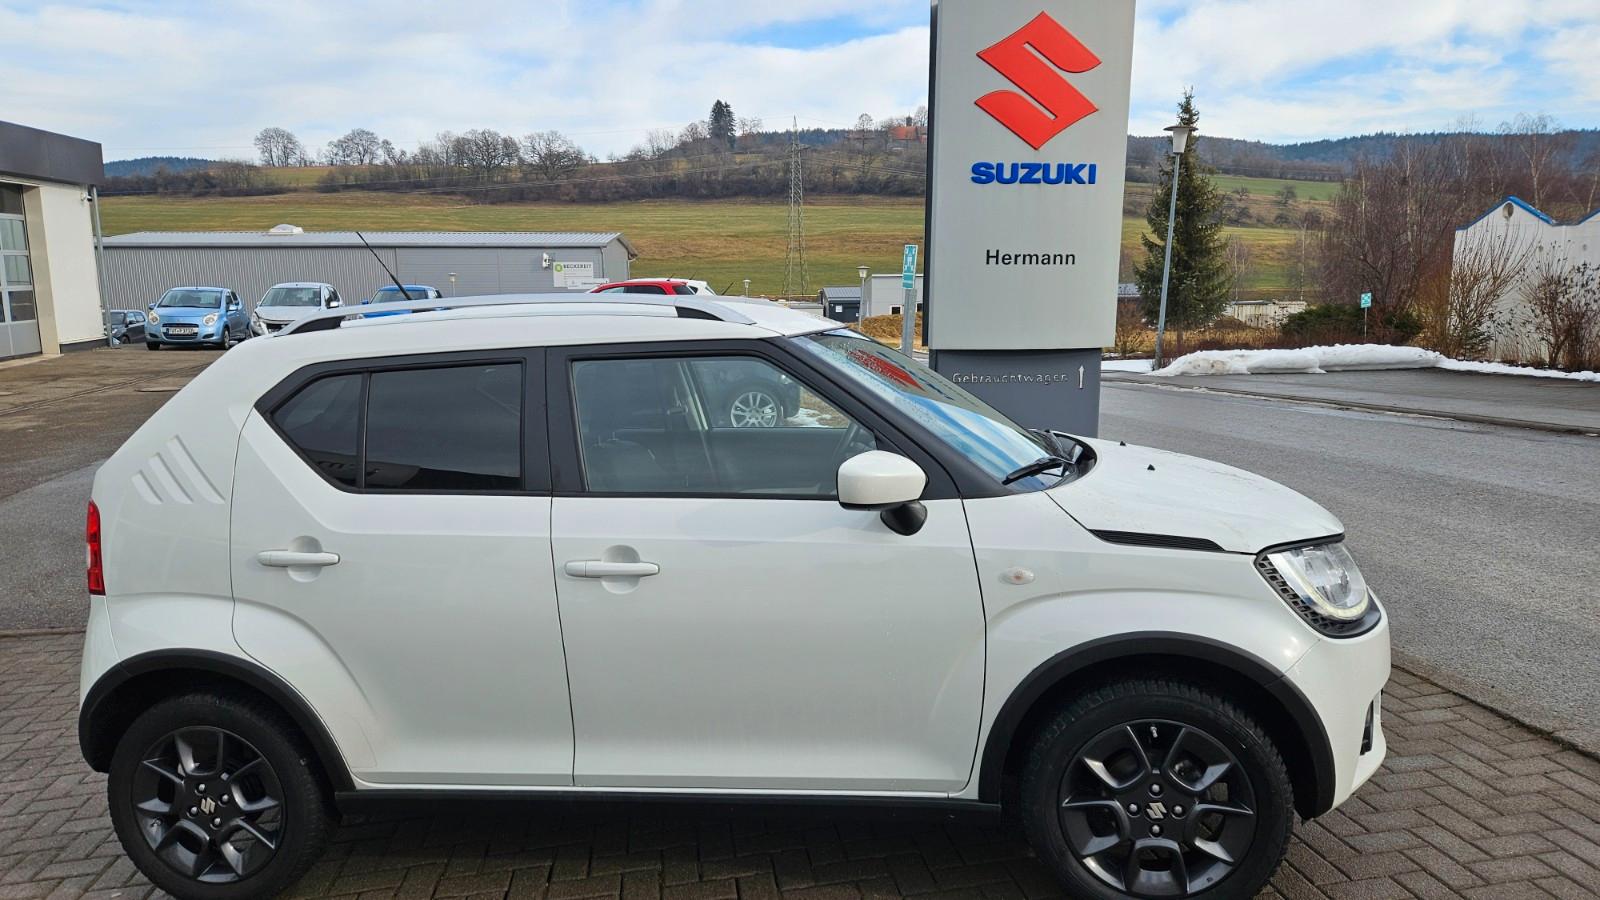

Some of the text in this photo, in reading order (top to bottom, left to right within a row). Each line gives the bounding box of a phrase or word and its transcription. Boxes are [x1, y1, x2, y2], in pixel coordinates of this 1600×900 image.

[971, 162, 1097, 185] SUZUKI
[985, 249, 1076, 265] Hermann
[952, 372, 1069, 386] Gebrauchtwagen
